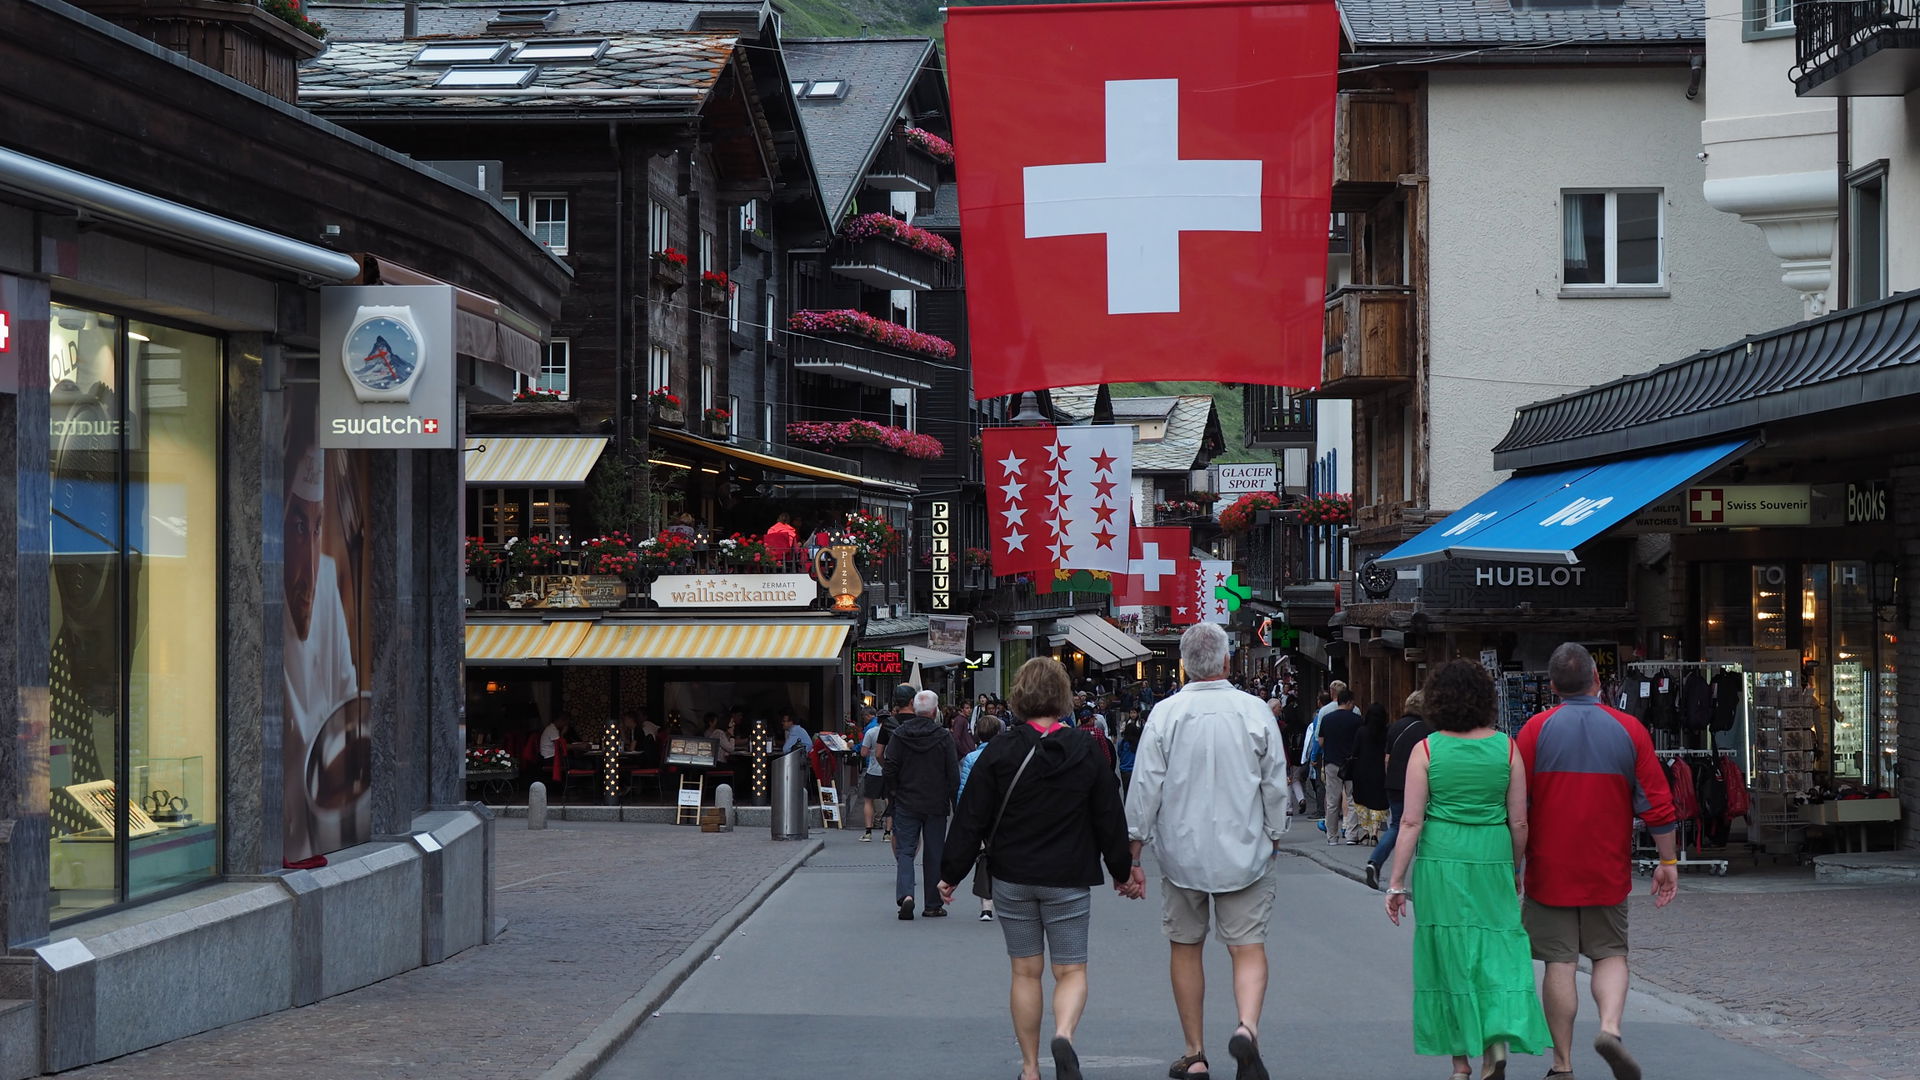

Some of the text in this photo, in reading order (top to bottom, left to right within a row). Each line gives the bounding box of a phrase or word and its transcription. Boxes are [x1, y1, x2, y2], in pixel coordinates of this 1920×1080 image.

[332, 415, 421, 434] swatch
[1221, 467, 1273, 478] GLACIER
[1228, 479, 1267, 489] SPORT
[1726, 499, 1809, 510] Swiss Souvenir
[1847, 481, 1887, 522] Books
[1635, 518, 1679, 526] WATCHES
[933, 503, 948, 608] POLLUX
[1475, 566, 1586, 587] HUBLOT
[762, 581, 796, 589] ZERMATT
[671, 587, 797, 603] walliserkanne
[857, 652, 899, 662] KITCHEN
[855, 662, 901, 672] OPEN LATE
